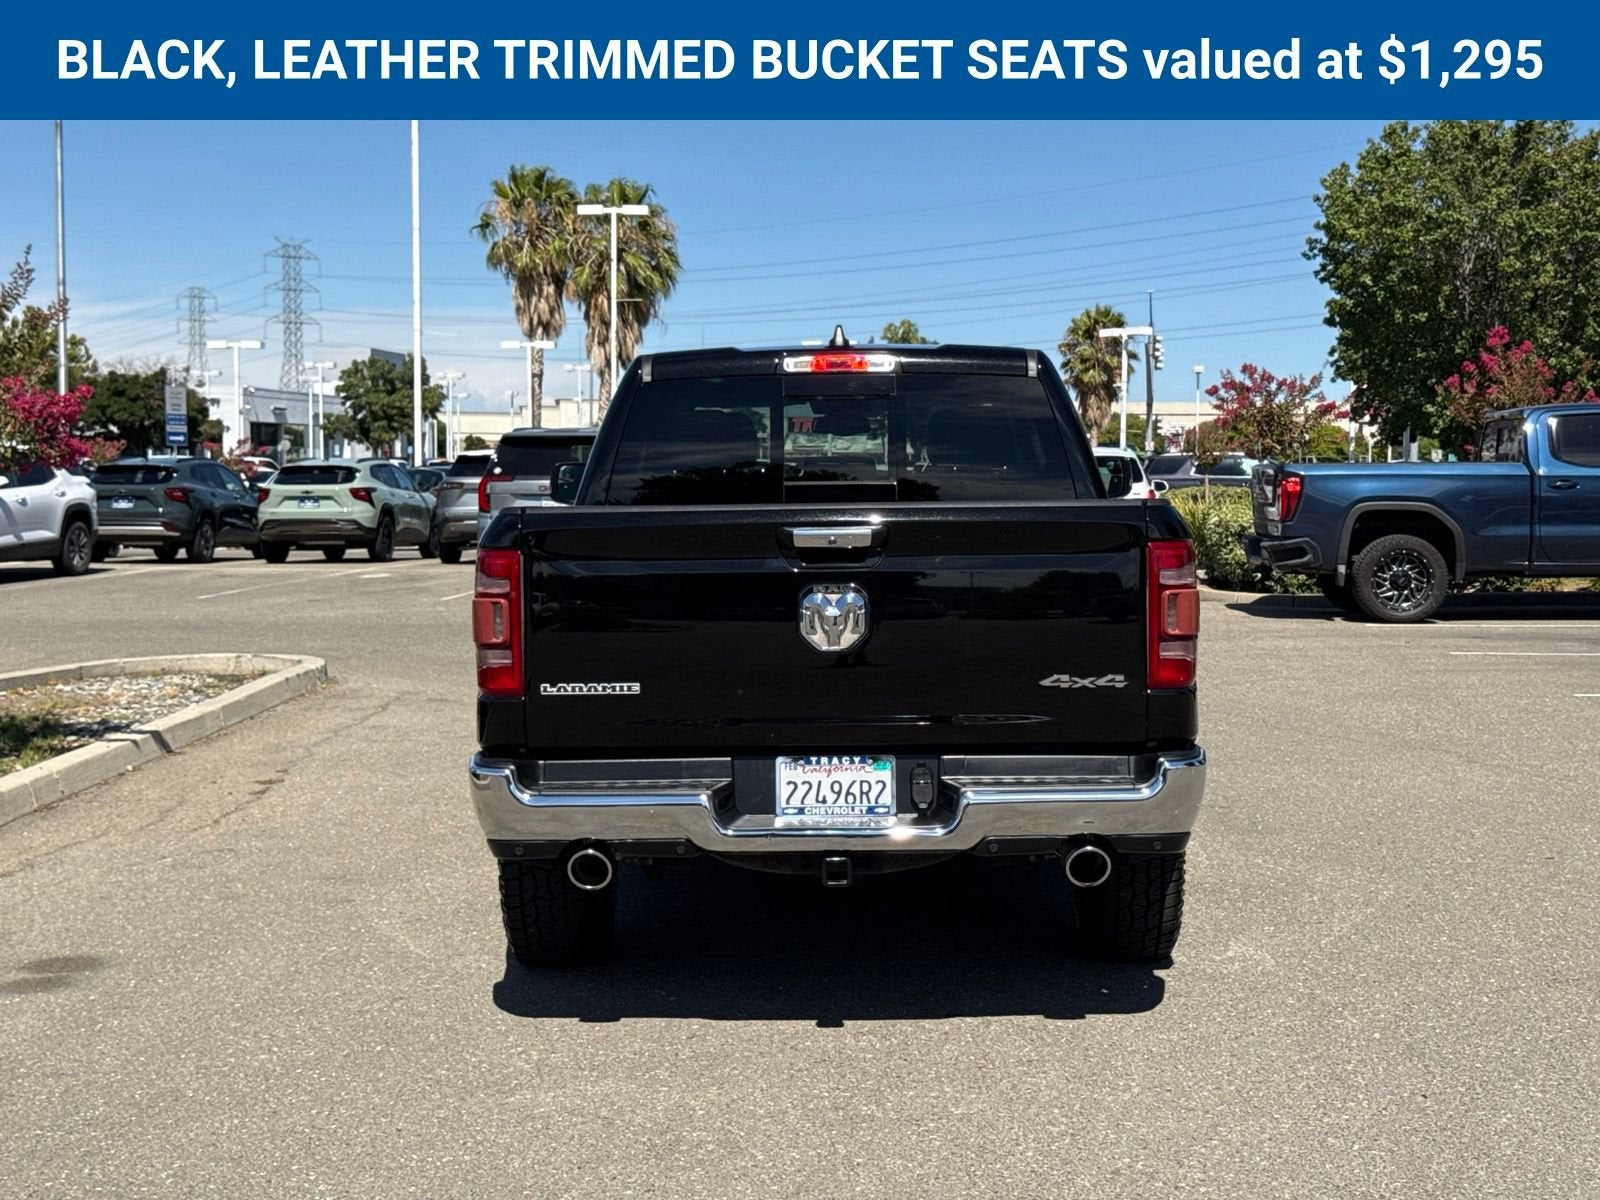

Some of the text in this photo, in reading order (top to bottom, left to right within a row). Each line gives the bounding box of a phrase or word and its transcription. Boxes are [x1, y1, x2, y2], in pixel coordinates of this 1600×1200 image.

[1038, 673, 1129, 688] 4x4
[540, 682, 641, 695] LARAMIE
[810, 756, 862, 765] TRACY
[784, 763, 799, 771] FEB
[785, 780, 887, 805] 22496R2
[804, 806, 868, 815] CHEVROLET
